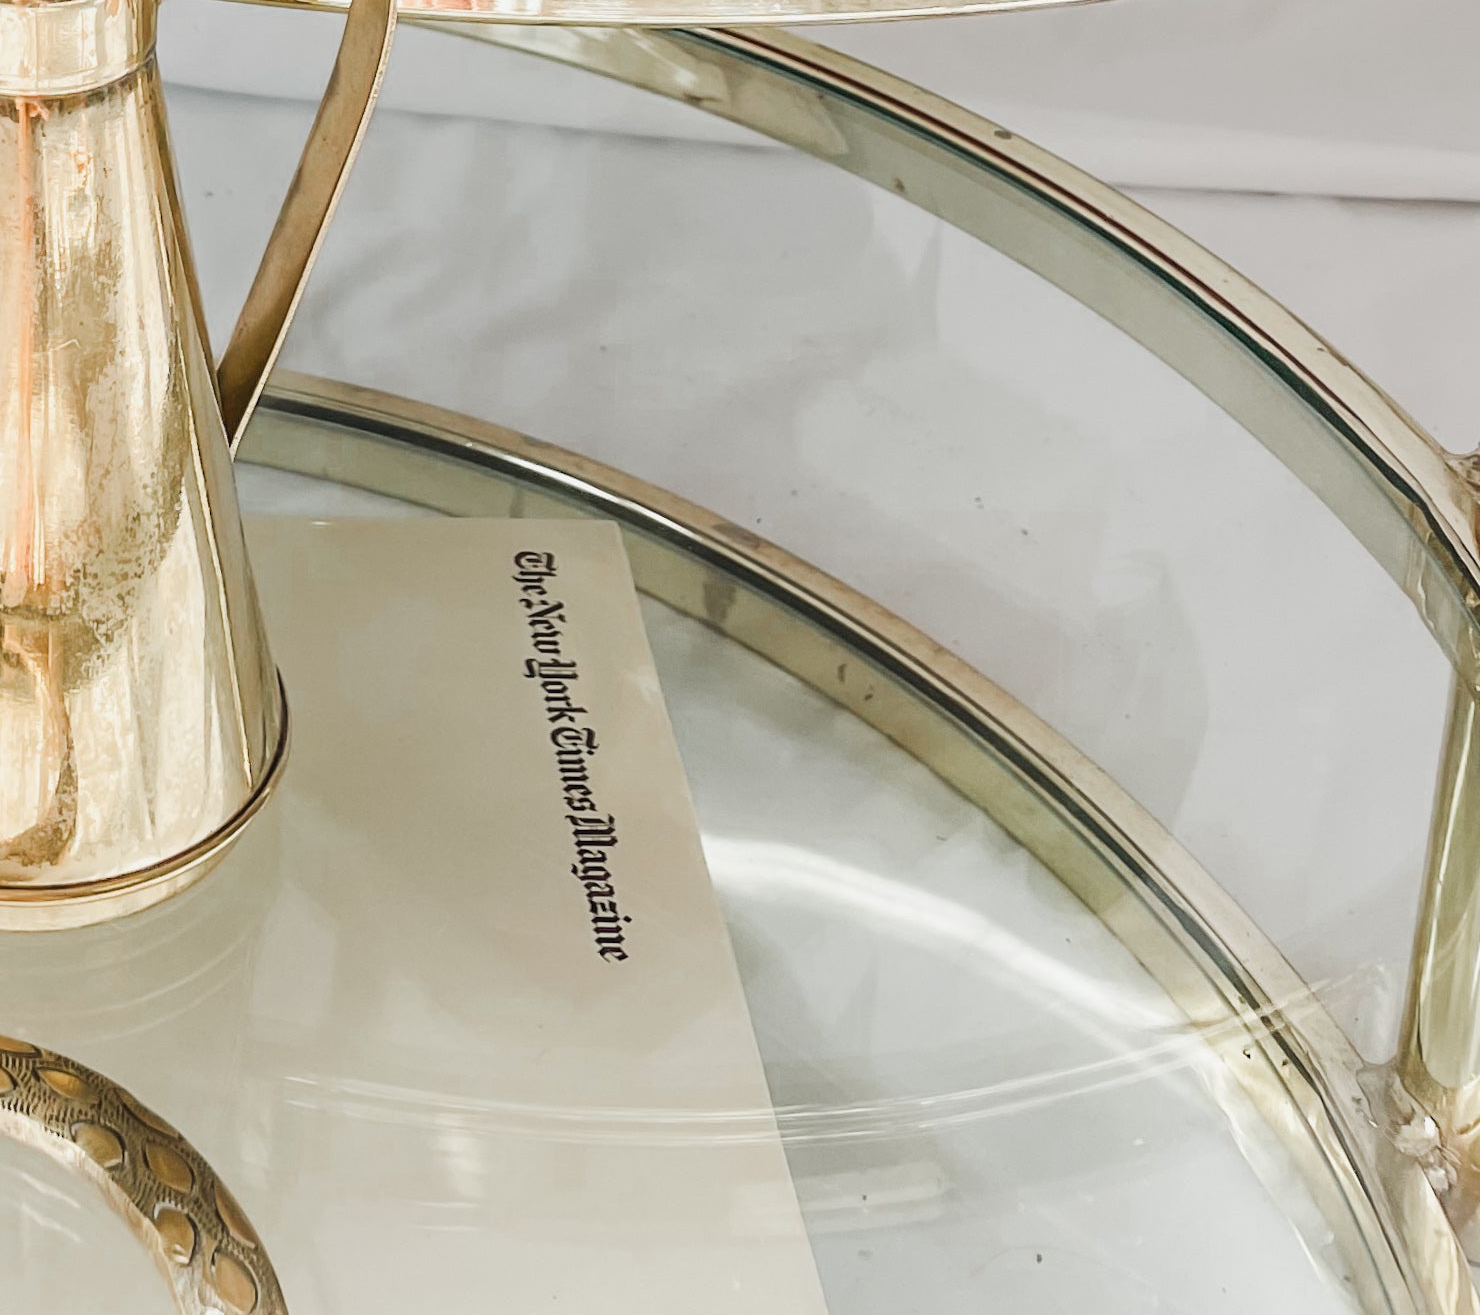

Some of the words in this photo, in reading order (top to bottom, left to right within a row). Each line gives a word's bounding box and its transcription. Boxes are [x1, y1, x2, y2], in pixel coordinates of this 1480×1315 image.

[512, 551, 557, 596] The
[518, 598, 567, 656] New
[523, 658, 588, 723] York
[550, 726, 600, 812] Times
[564, 813, 633, 963] Magazine
